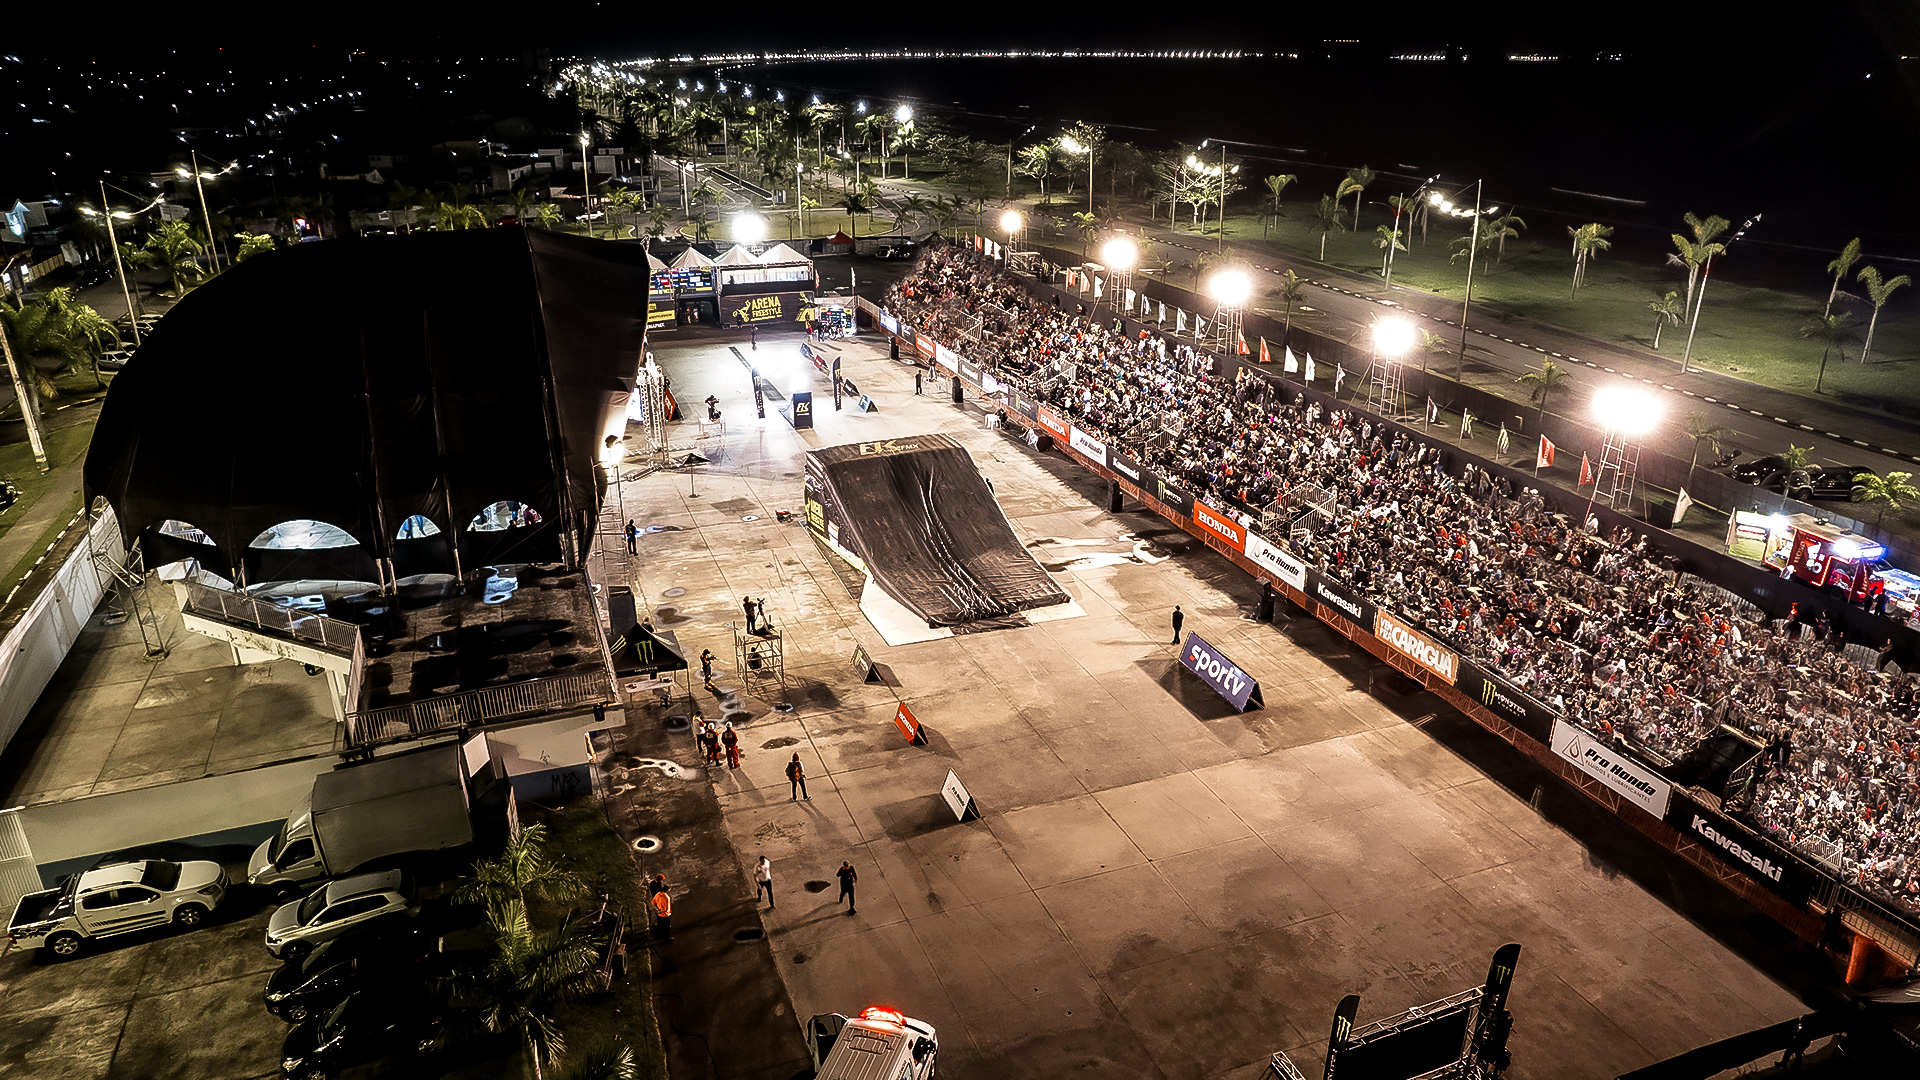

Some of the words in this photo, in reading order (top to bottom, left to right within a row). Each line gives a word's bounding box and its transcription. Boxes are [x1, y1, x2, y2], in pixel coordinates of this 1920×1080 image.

[752, 296, 782, 310] ARENA
[752, 306, 783, 318] FREESTYLE
[1040, 413, 1067, 437] HONDA
[1197, 510, 1240, 544] HONDA
[1262, 548, 1276, 561] Pro
[1275, 556, 1300, 576] Honda
[1317, 581, 1363, 619] Kawasaki
[1380, 616, 1393, 631] VEM
[1190, 644, 1246, 697] sportv
[1494, 691, 1527, 716] MONSTER
[1584, 748, 1611, 769] Pro
[1610, 764, 1657, 796] Honda
[1691, 814, 1784, 883] Kawasaki
